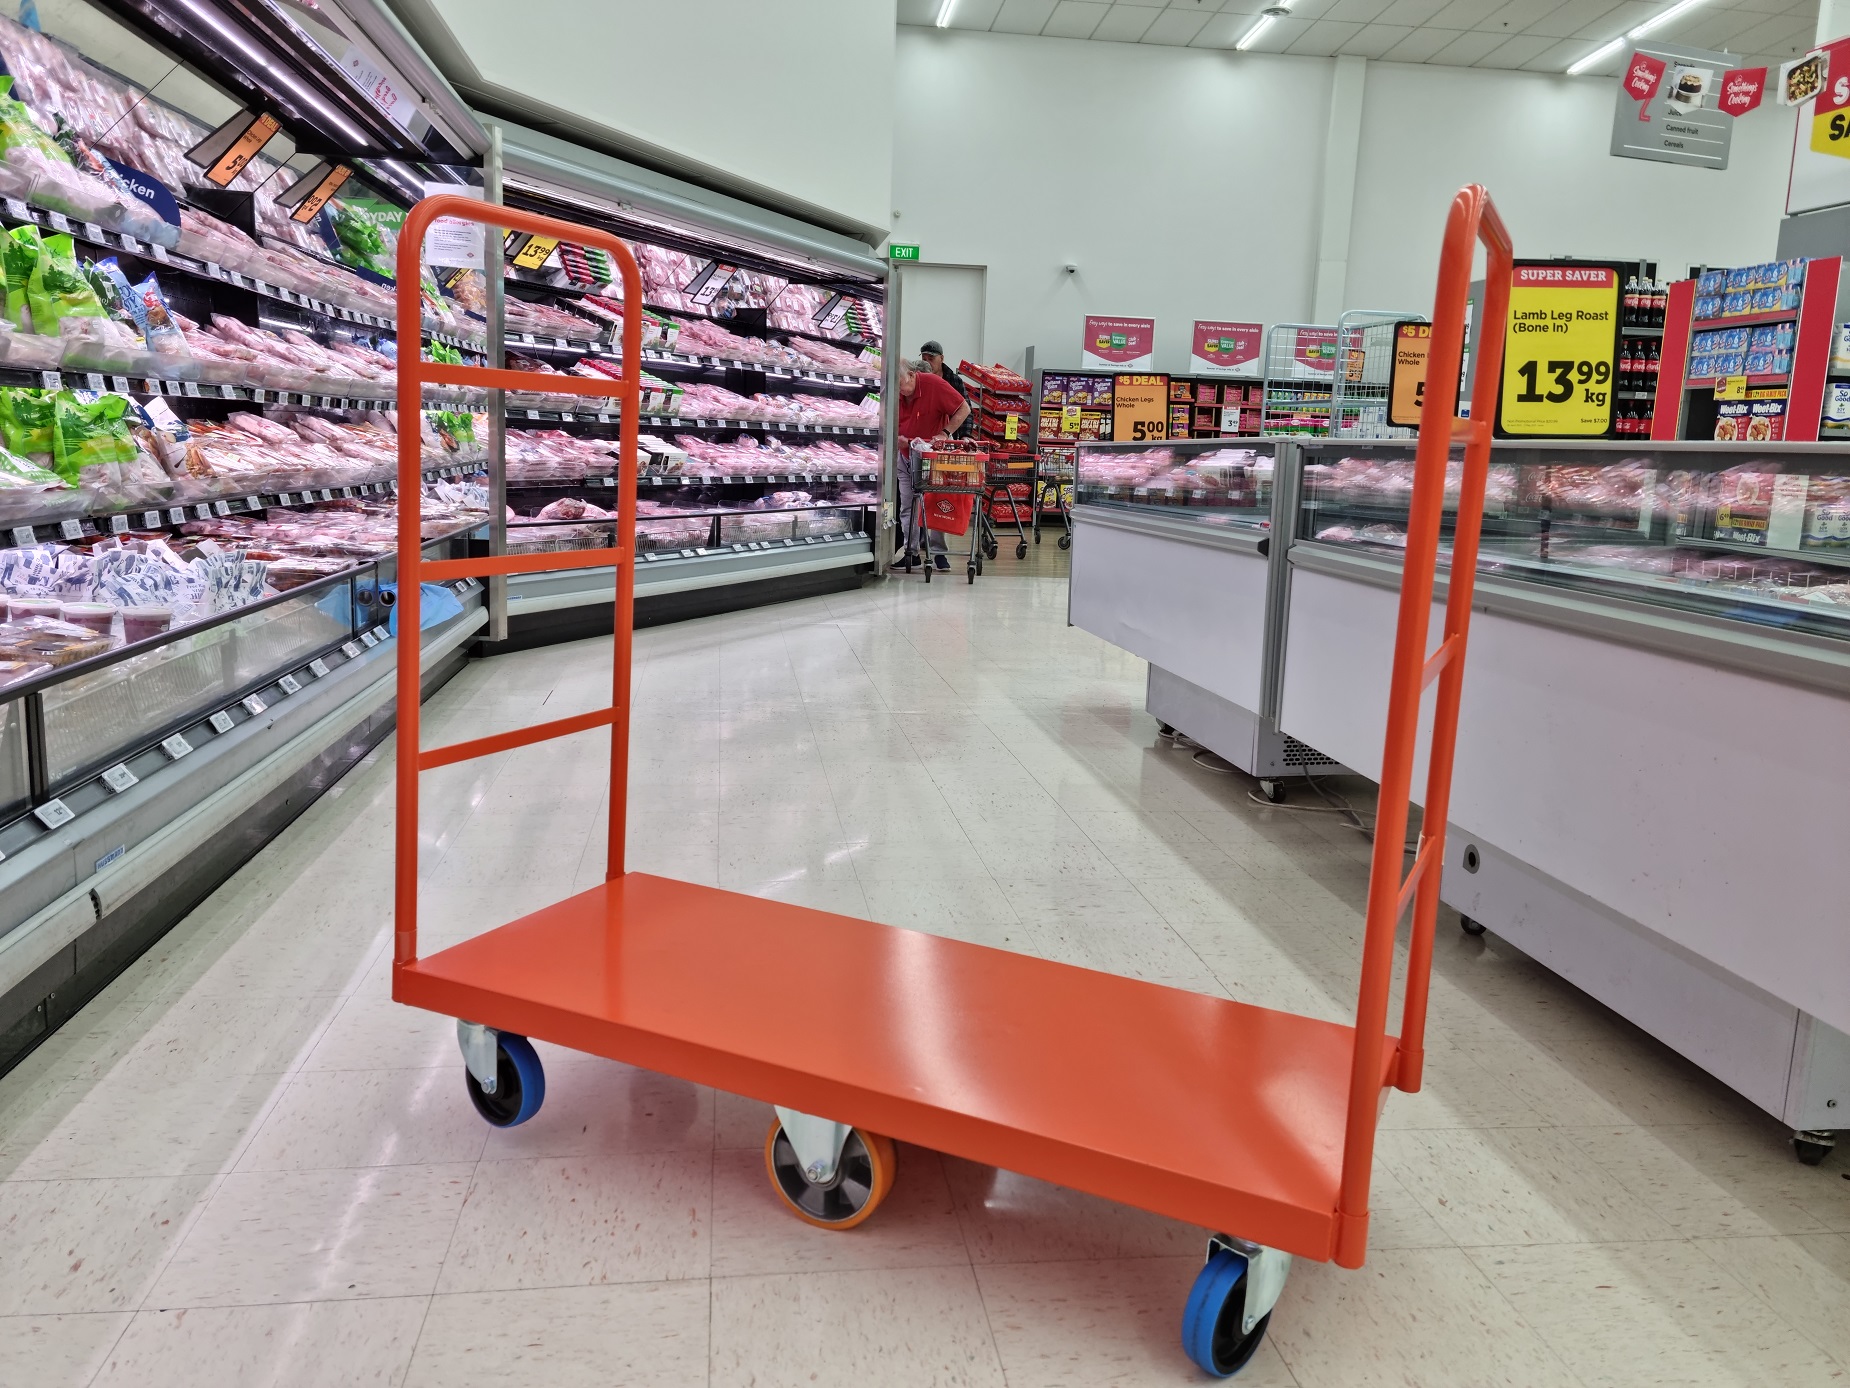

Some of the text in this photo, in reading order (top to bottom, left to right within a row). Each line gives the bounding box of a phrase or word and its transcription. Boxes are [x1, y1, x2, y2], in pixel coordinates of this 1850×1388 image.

[1728, 93, 1751, 107] Cooking
[1666, 125, 1699, 135] Canned fruit
[1664, 140, 1684, 149] Cereals
[895, 247, 914, 258] EXIT
[1520, 269, 1607, 281] SUPER SAVER
[1513, 309, 1609, 322] Lamb Leg Roast
[1402, 325, 1416, 337] $5
[1513, 322, 1568, 334] (Bone In)
[1119, 375, 1164, 385] $5 DEAL
[1584, 388, 1607, 407] kg
[1720, 404, 1748, 414] Weet-Bix
[1752, 403, 1782, 413] Weet-Bix
[1732, 530, 1761, 544] Weet-Bix
